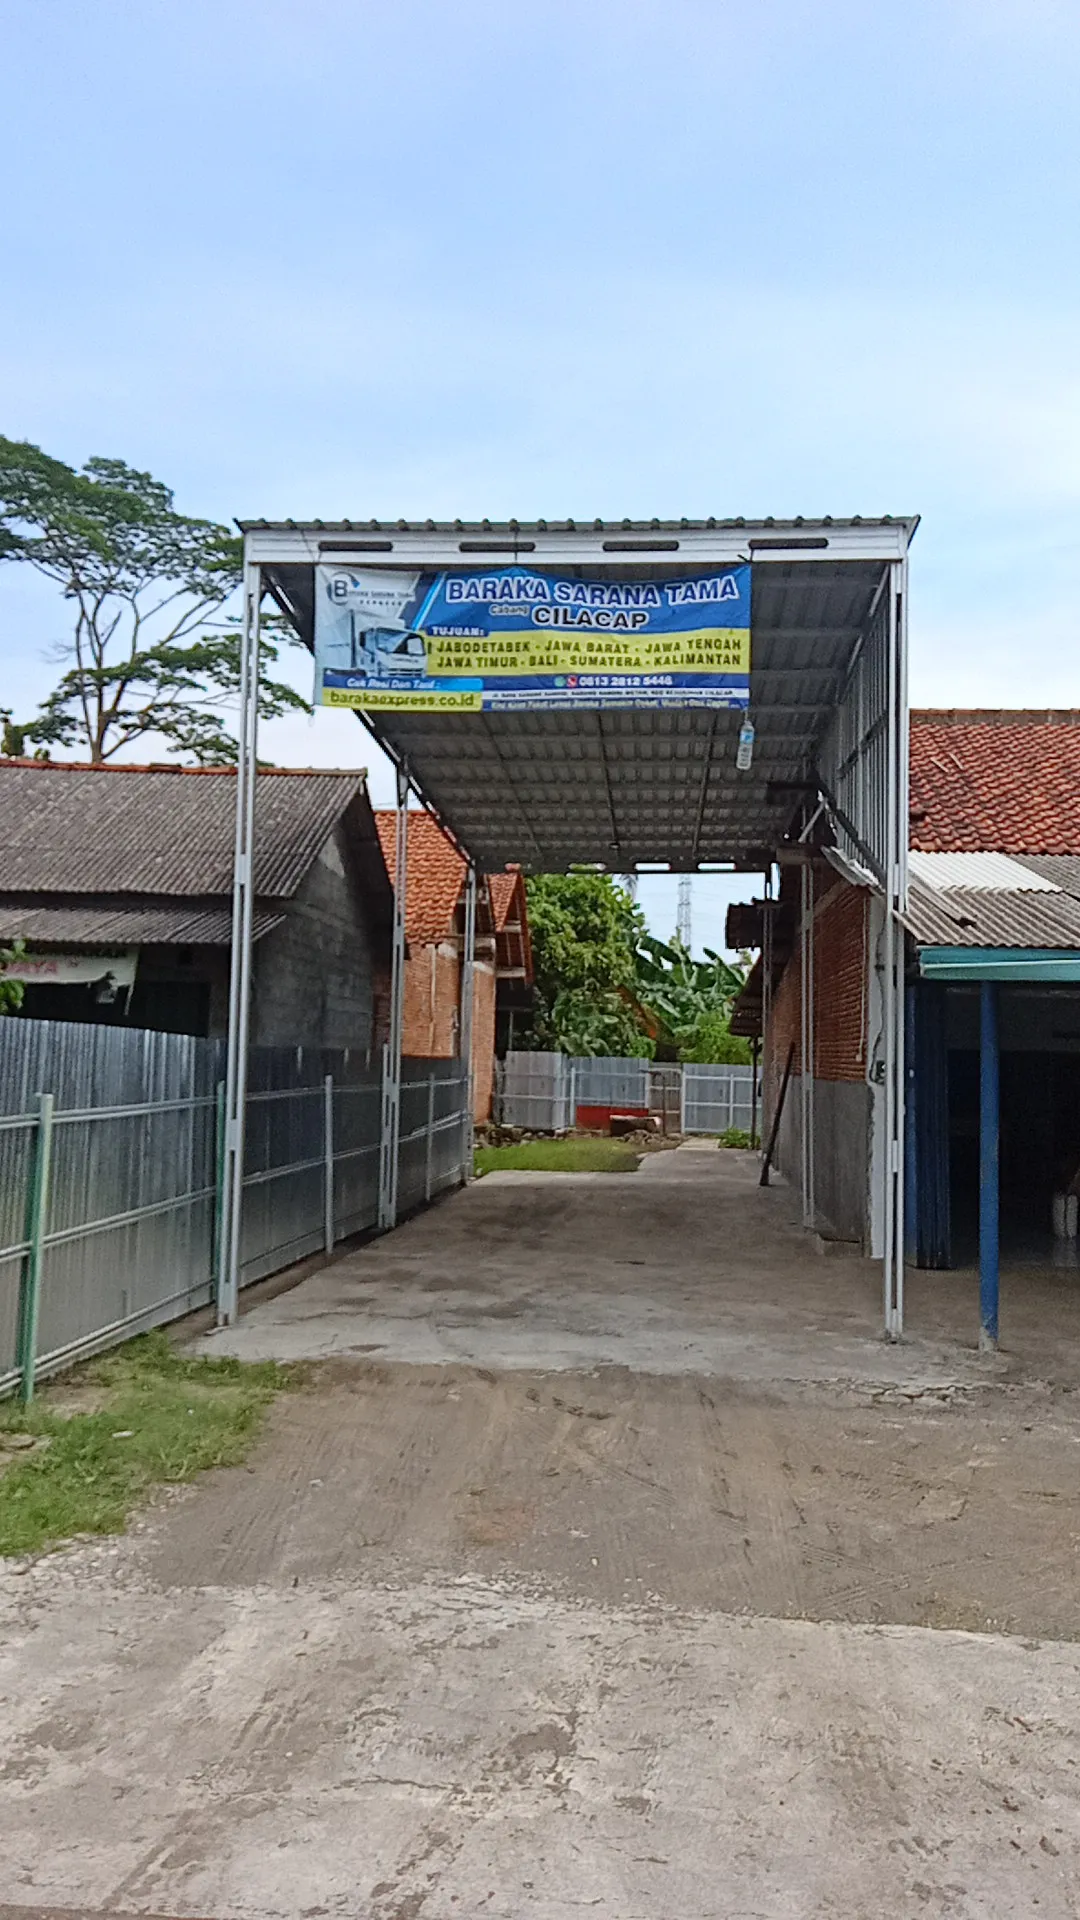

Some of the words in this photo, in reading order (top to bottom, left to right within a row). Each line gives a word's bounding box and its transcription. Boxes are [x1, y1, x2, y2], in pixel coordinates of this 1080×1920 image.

[447, 577, 550, 602] BARAKA
[555, 583, 661, 607] SARANA
[665, 576, 739, 605] TAMA
[489, 604, 530, 618] Cabang
[532, 606, 649, 629] CILACAP
[437, 641, 531, 654] JABODETABEK
[545, 640, 581, 653] JAWA
[586, 641, 630, 654] BARAT
[645, 642, 681, 654] JAWA
[687, 638, 742, 651] TENGAH
[437, 656, 472, 668] JAWA
[477, 656, 518, 668] TIMUR
[529, 655, 558, 667] BALI
[570, 655, 641, 667] SUMATERA
[654, 653, 741, 667] KALIMANTAN
[330, 691, 475, 707] barakaexpress.co.id
